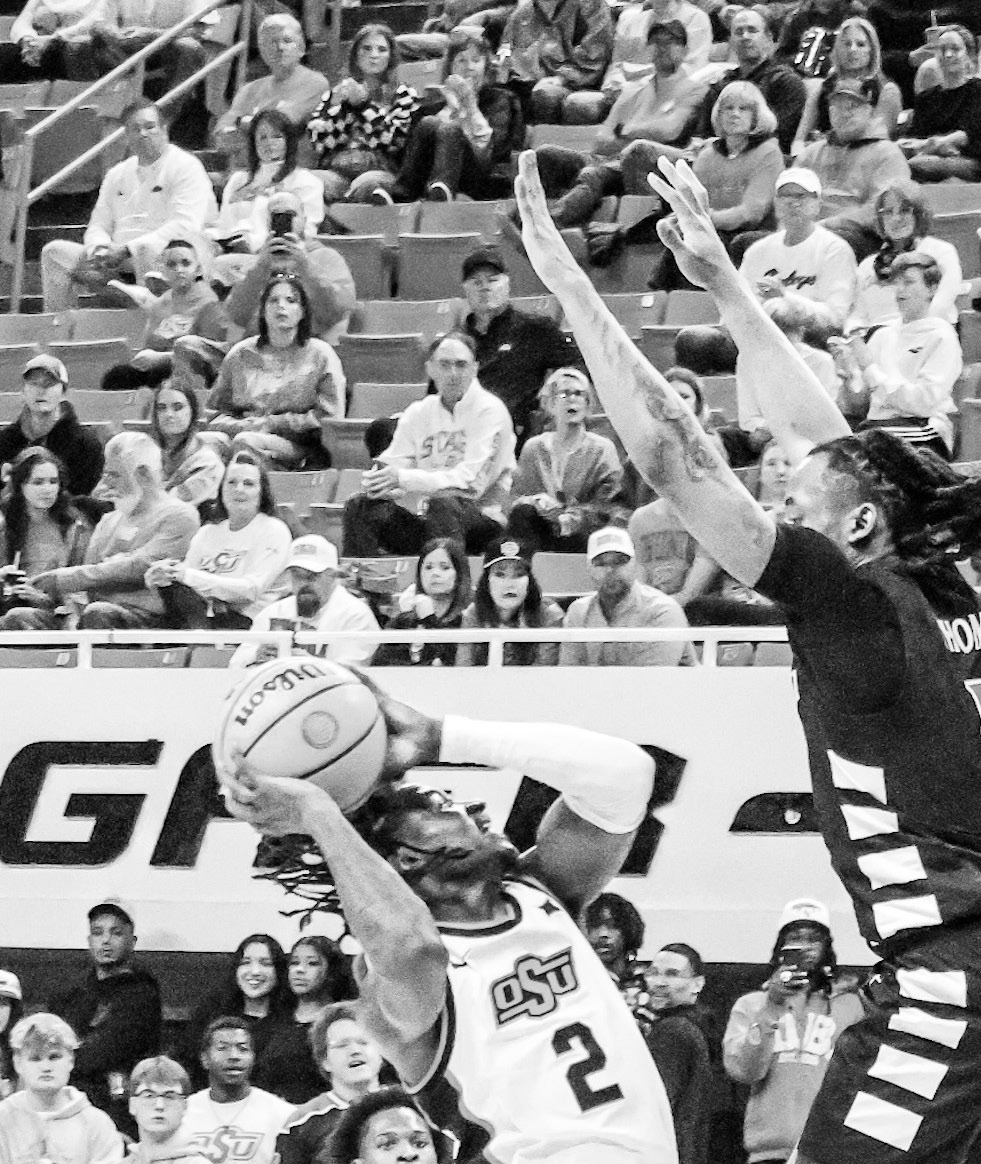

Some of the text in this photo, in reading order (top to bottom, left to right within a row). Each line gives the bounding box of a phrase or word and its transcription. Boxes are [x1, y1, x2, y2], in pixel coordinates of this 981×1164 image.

[235, 663, 327, 726] Wilson
[489, 947, 579, 1028] OSU
[551, 1022, 625, 1114] 2
